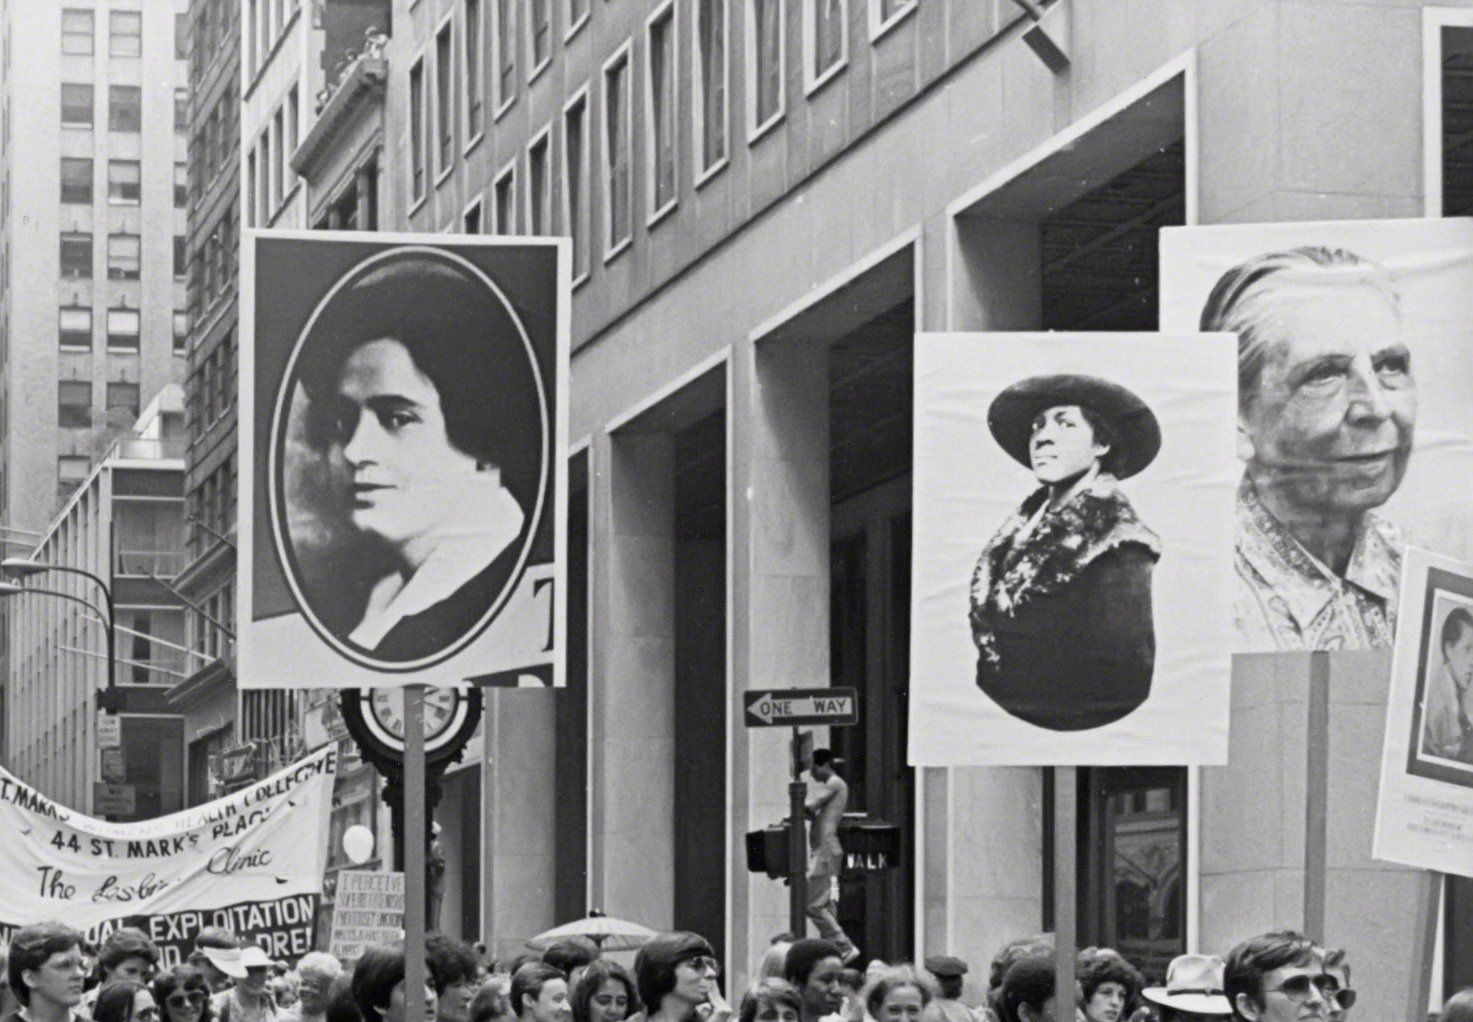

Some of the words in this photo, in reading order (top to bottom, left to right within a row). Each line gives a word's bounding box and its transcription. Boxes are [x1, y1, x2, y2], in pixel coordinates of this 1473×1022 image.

[759, 701, 793, 716] ONE
[813, 699, 846, 714] WAY
[50, 829, 82, 854] 44
[90, 838, 120, 858] ST.
[127, 831, 200, 859] MARK'S
[37, 865, 76, 901] The
[205, 846, 273, 875] Clinic
